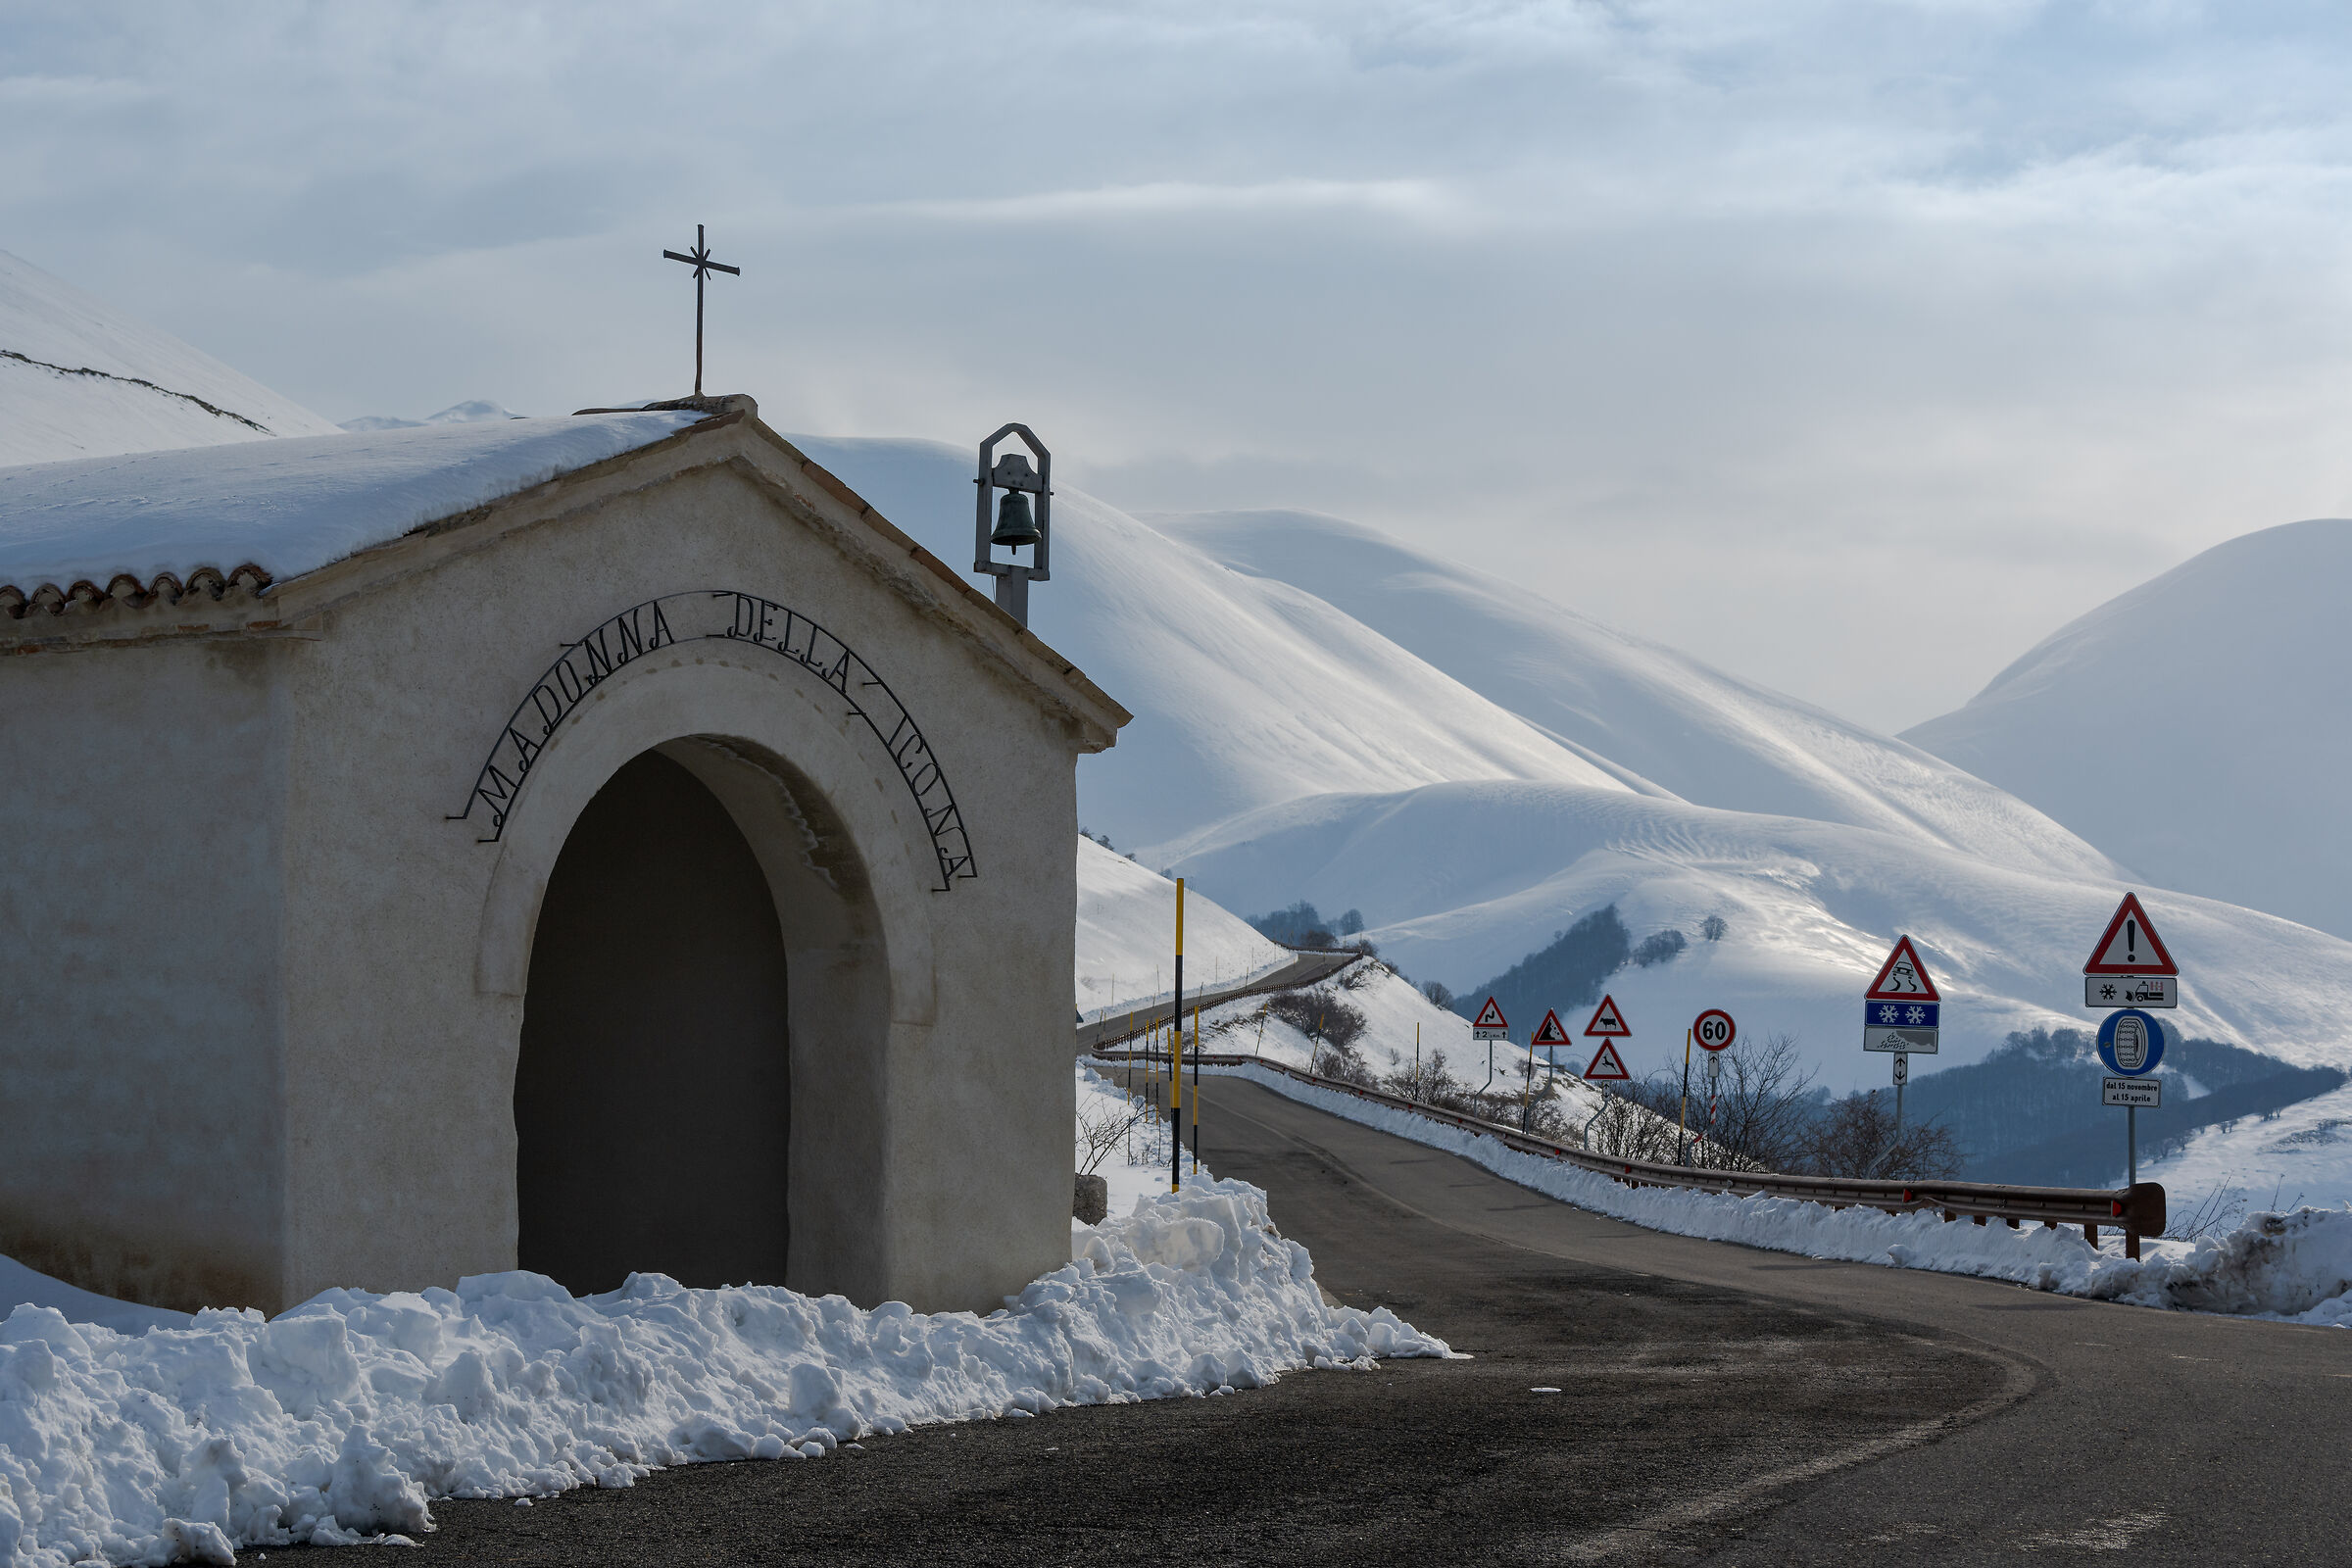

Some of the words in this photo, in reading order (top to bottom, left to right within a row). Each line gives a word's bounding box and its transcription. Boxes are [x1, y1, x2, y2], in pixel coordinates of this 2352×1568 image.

[477, 600, 675, 828] MADONNA
[726, 593, 852, 694] DELLA
[887, 713, 971, 880] ICONA
[1703, 1020, 1726, 1040] 60
[2128, 1083, 2158, 1092] novembre
